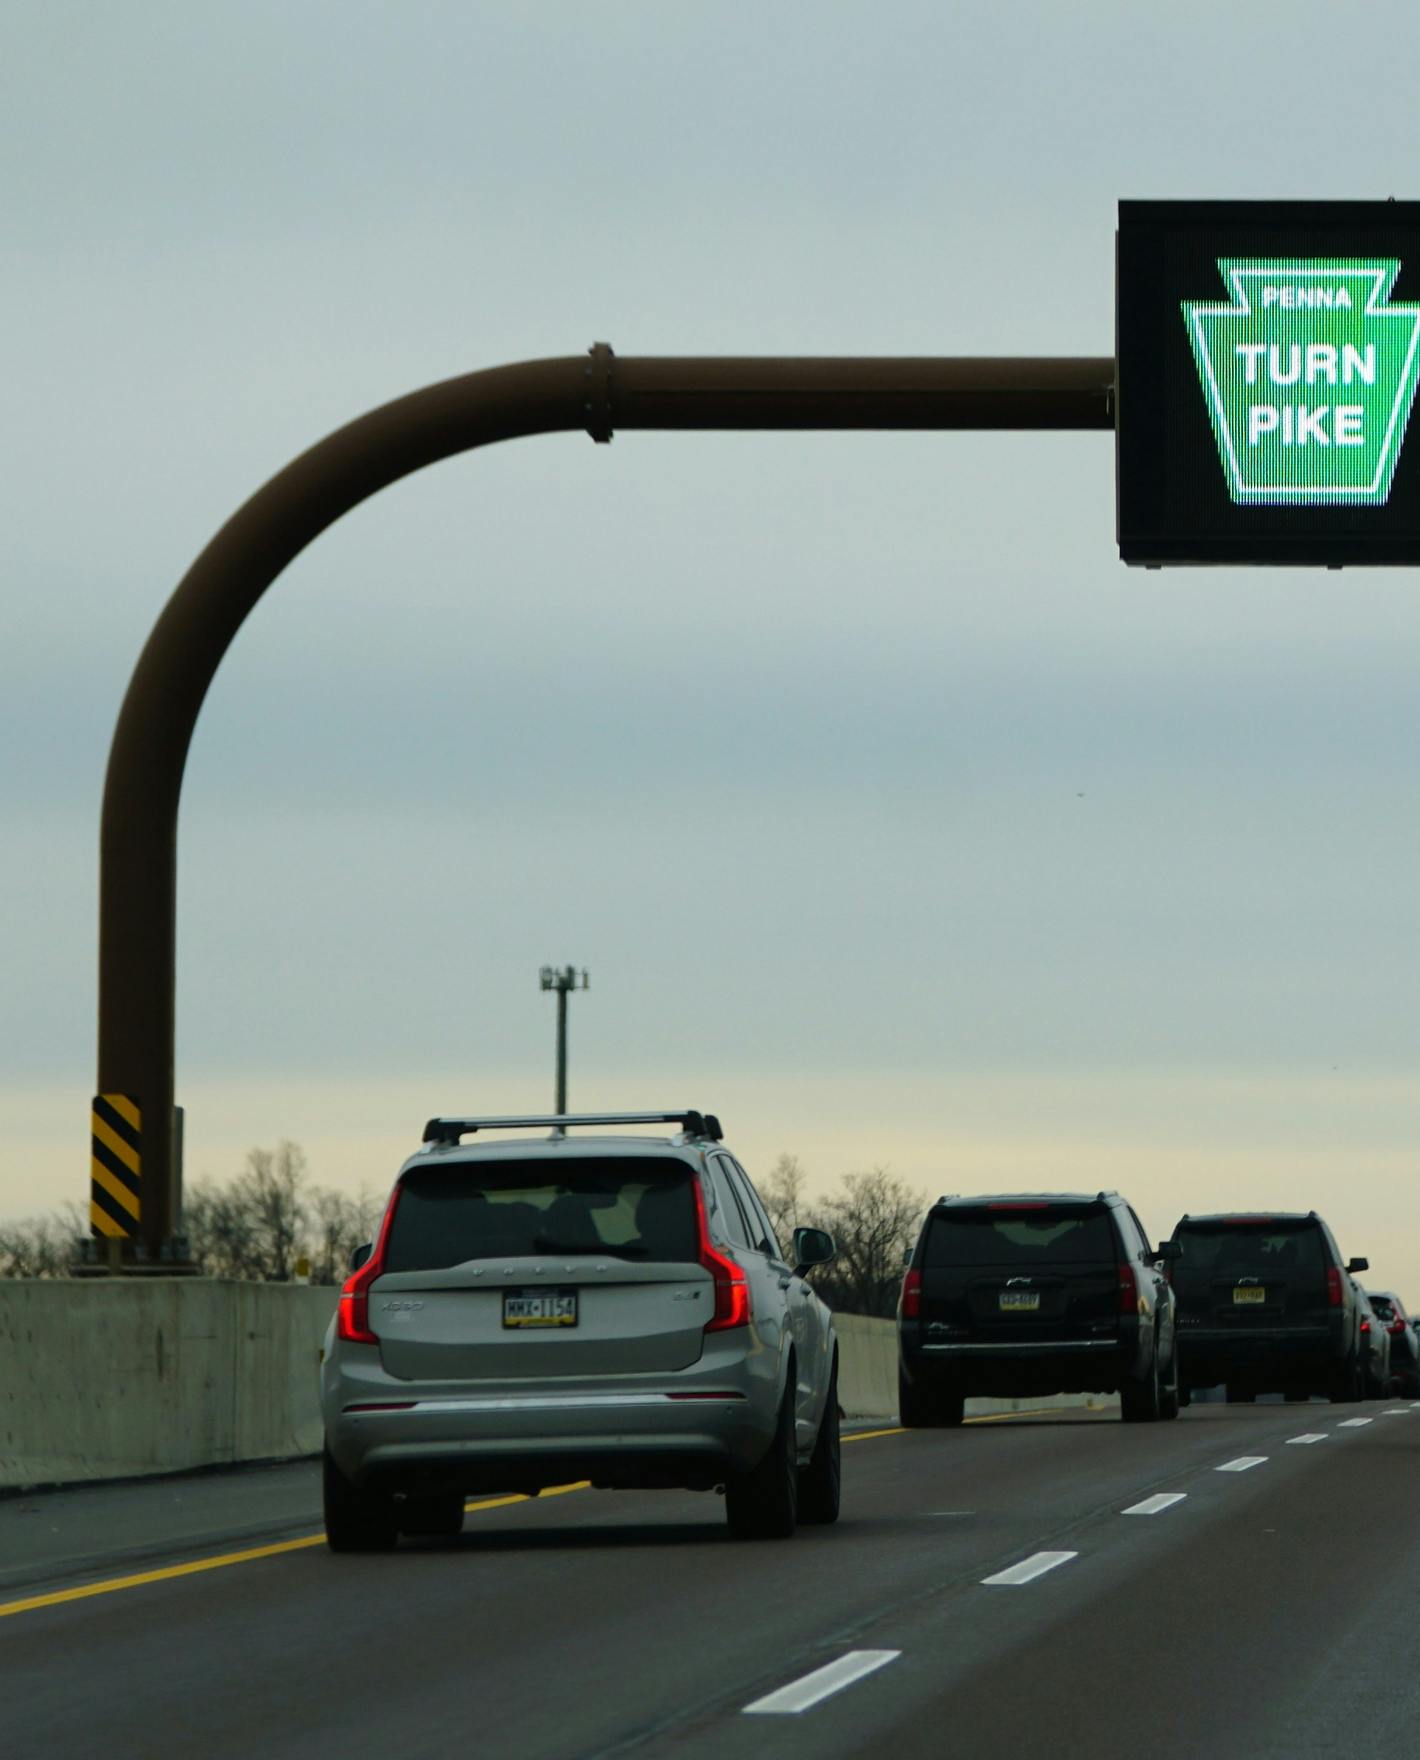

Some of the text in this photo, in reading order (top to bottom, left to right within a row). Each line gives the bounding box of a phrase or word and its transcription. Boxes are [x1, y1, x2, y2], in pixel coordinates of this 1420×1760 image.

[1262, 285, 1353, 309] PENNA
[1235, 343, 1377, 386] TURN
[1248, 403, 1365, 447] PIKE
